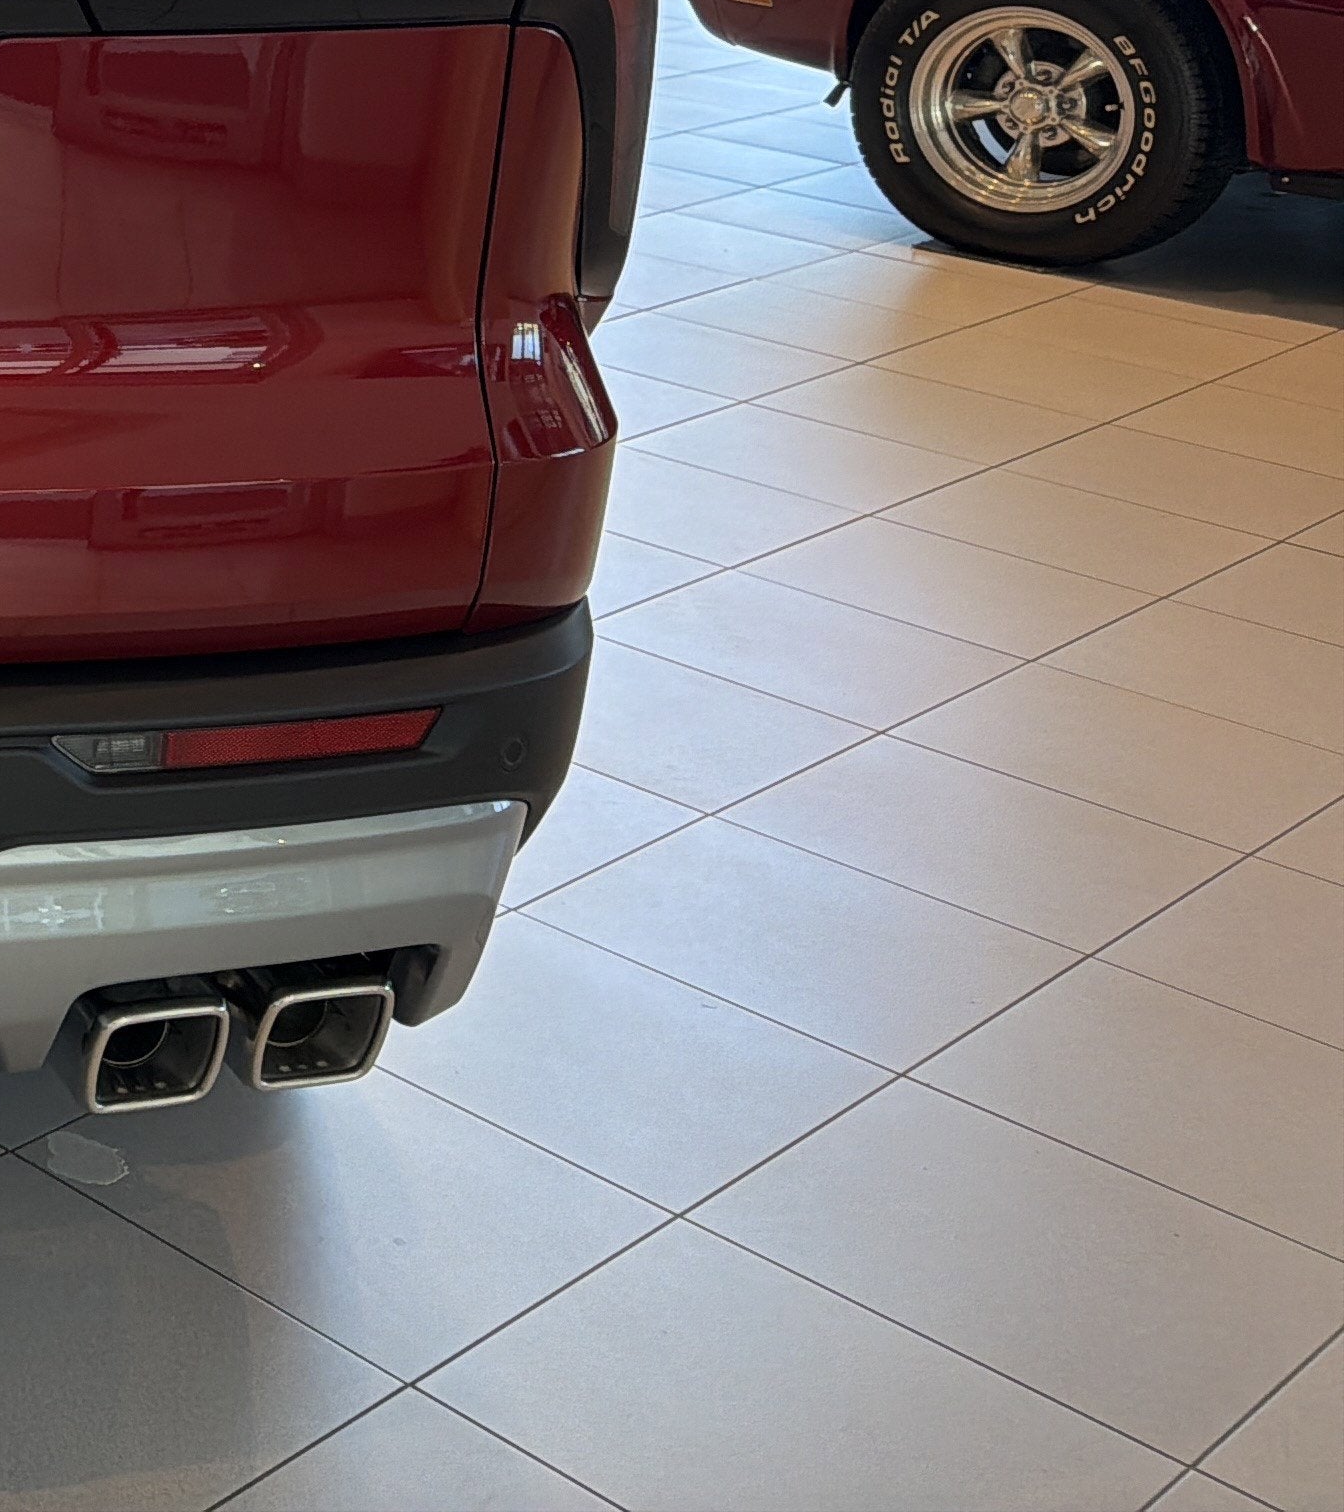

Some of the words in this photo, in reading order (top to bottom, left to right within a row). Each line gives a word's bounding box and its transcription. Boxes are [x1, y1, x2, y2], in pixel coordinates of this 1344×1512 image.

[879, 54, 911, 163] Radial
[898, 10, 941, 46] T/A
[1074, 35, 1157, 224] BFGoodrich
